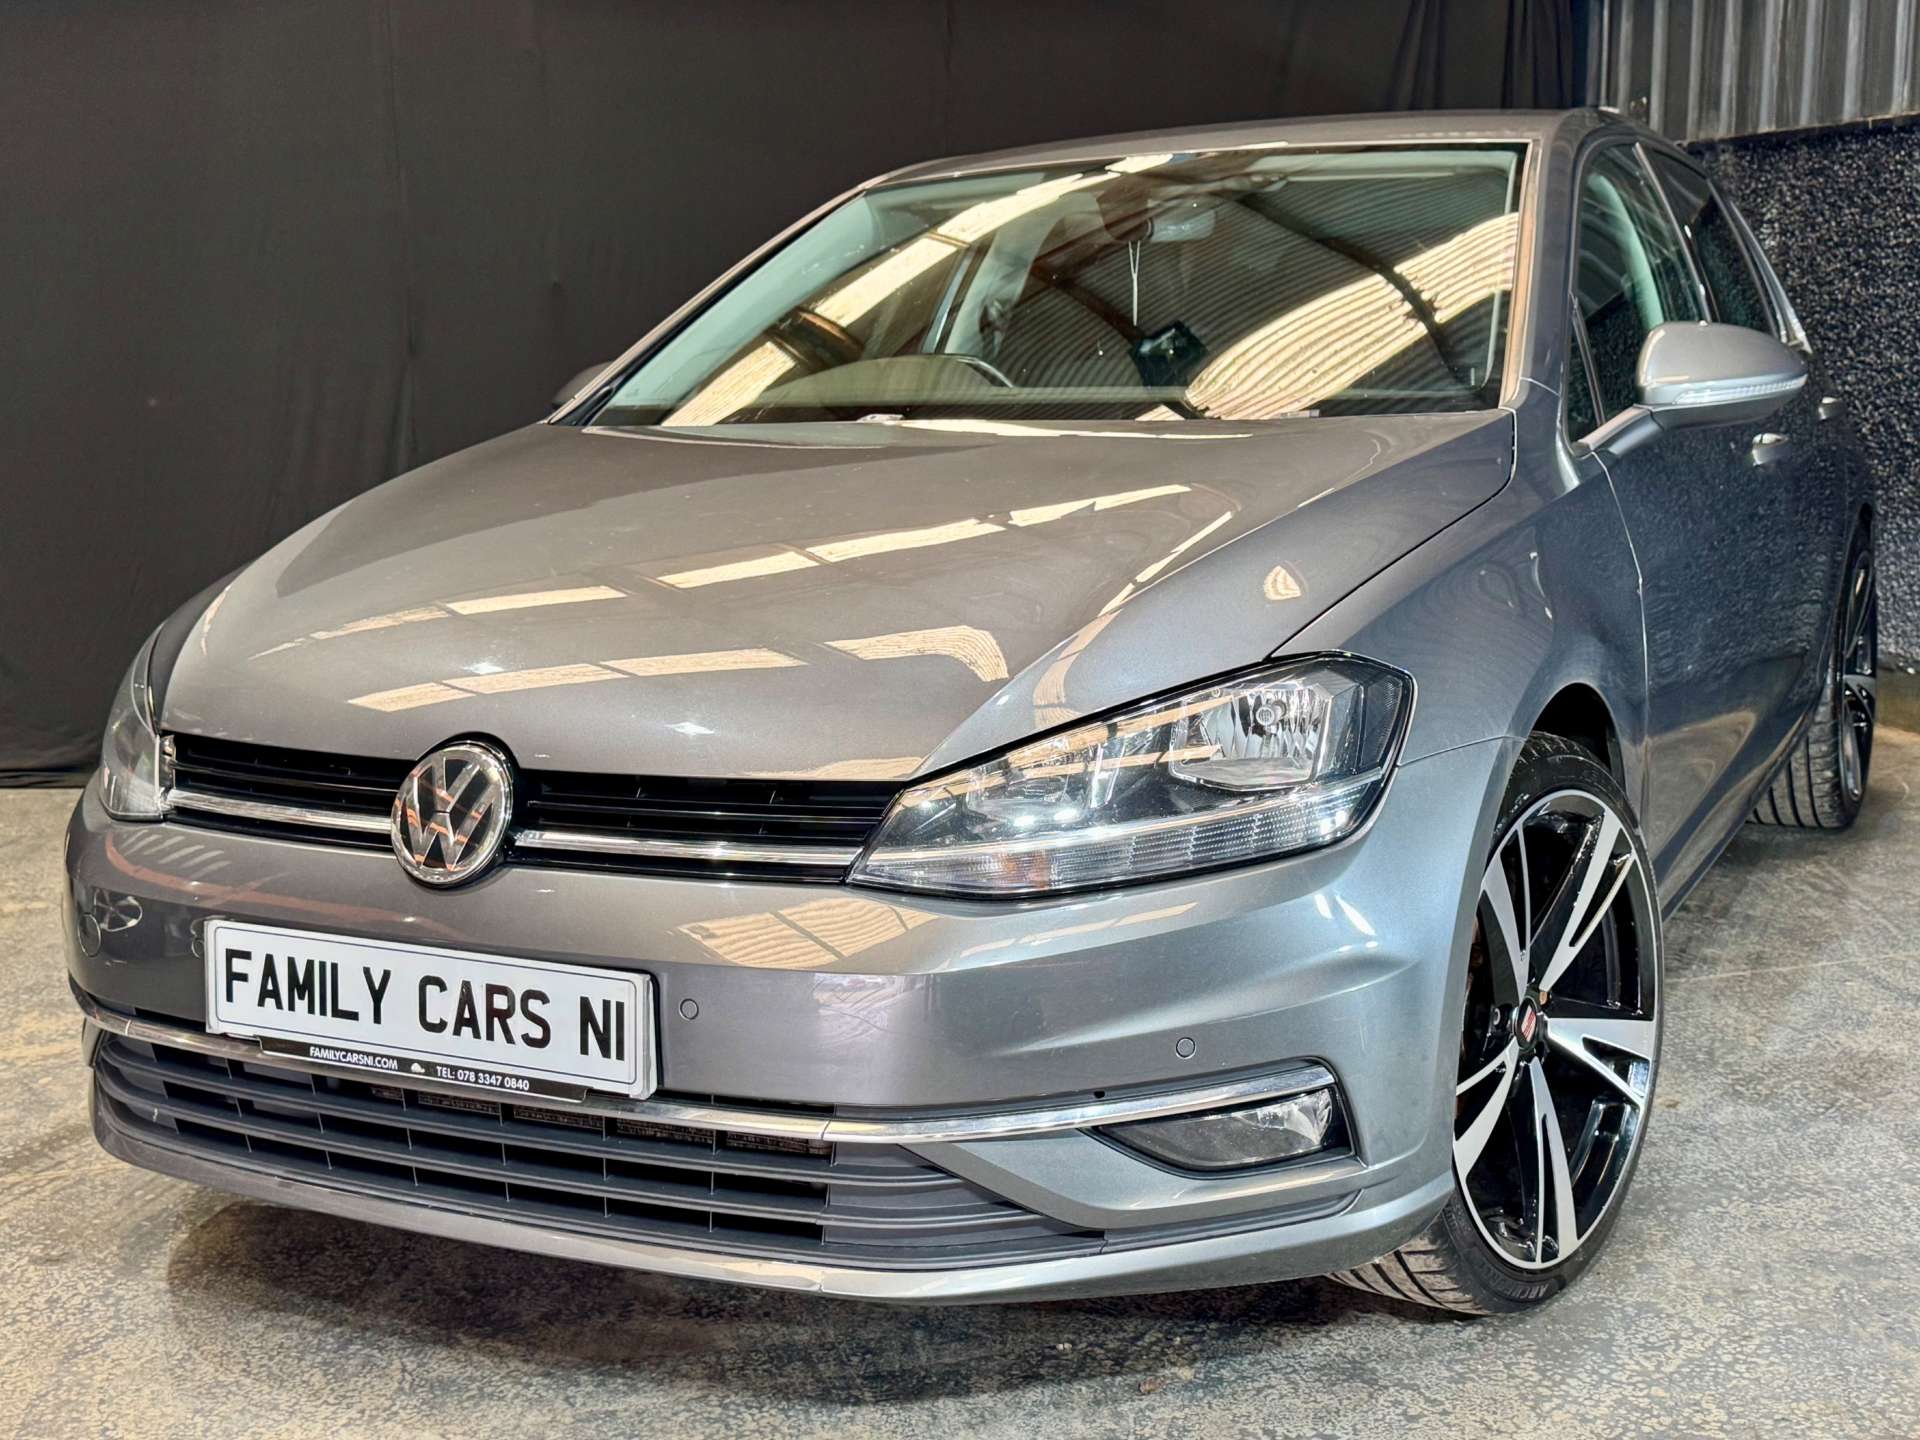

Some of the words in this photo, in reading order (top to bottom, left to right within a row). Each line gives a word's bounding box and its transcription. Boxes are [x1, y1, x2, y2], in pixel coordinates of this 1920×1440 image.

[225, 948, 392, 1025] FAMILY
[418, 974, 552, 1049] CARS
[579, 995, 626, 1062] NI
[309, 1046, 399, 1071] FAMILYCARSNI.COM
[436, 1065, 456, 1079] TEL:
[457, 1070, 476, 1083] 078
[477, 1072, 503, 1087] 3347
[504, 1076, 530, 1091] 0840
